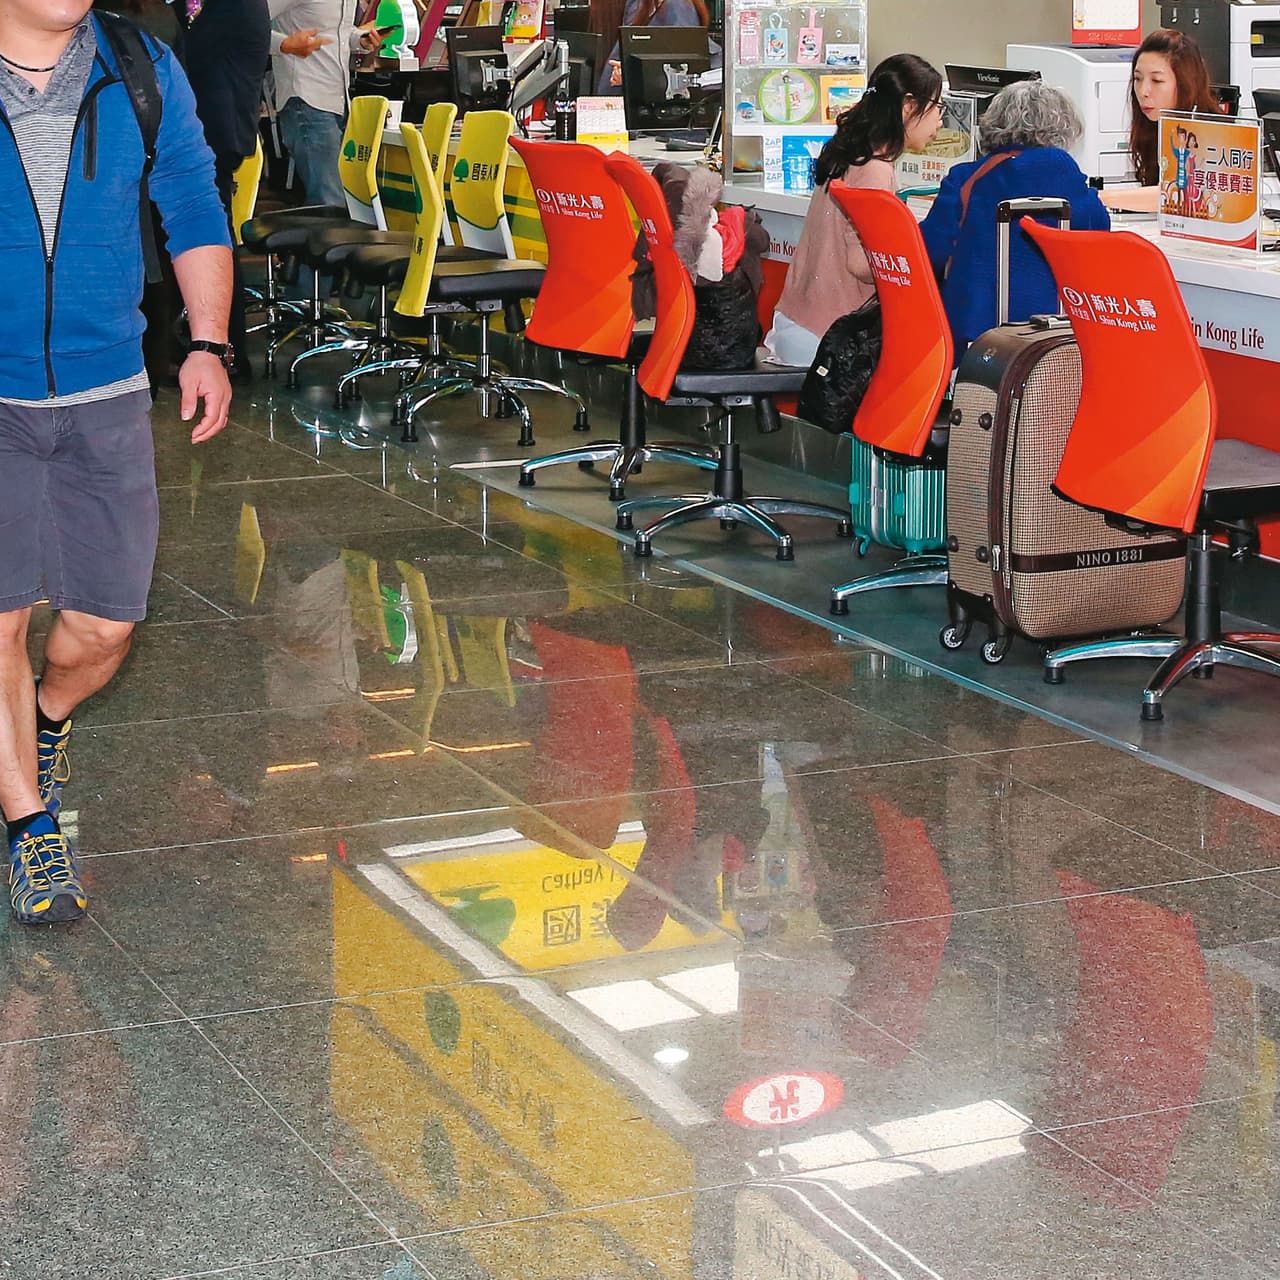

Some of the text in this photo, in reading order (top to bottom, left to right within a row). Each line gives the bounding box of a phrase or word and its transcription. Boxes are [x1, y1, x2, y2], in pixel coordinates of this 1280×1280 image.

[764, 137, 782, 147] ZAP
[764, 156, 782, 167] ZAP
[1205, 146, 1254, 170] 二人同行
[766, 172, 783, 181] ZAP
[1193, 169, 1254, 195] 享優惠費率
[556, 192, 604, 210] 新光人壽
[1090, 293, 1157, 319] 新光人壽
[1099, 314, 1157, 332] Shin Kong Life
[1206, 321, 1237, 350] Kong
[1241, 327, 1265, 350] Life
[1075, 549, 1144, 568] NINO 1881
